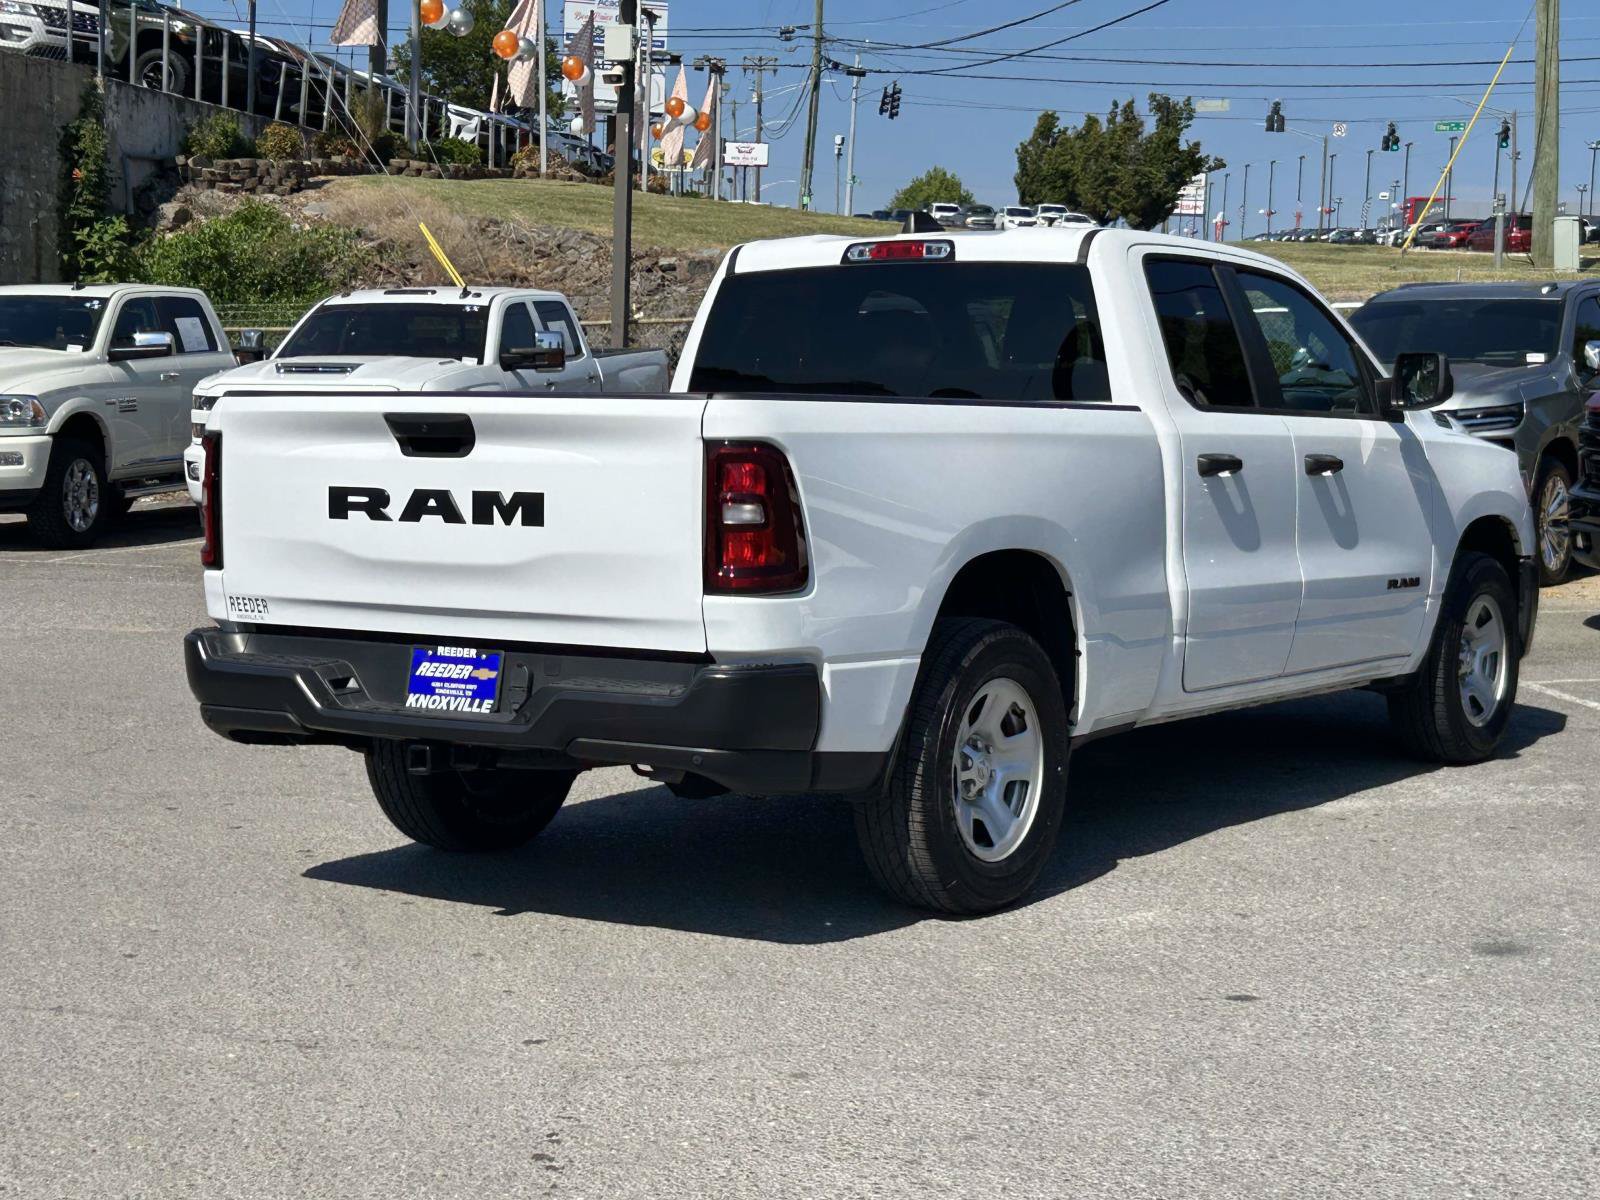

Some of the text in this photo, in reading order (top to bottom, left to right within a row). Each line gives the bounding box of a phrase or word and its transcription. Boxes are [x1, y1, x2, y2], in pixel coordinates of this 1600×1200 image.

[329, 486, 545, 527] RAM
[1387, 577, 1420, 590] RAM
[229, 596, 270, 615] REEDER
[437, 646, 477, 658] REEDER
[415, 662, 474, 680] REEDER
[405, 693, 494, 713] KNOXVILLE
